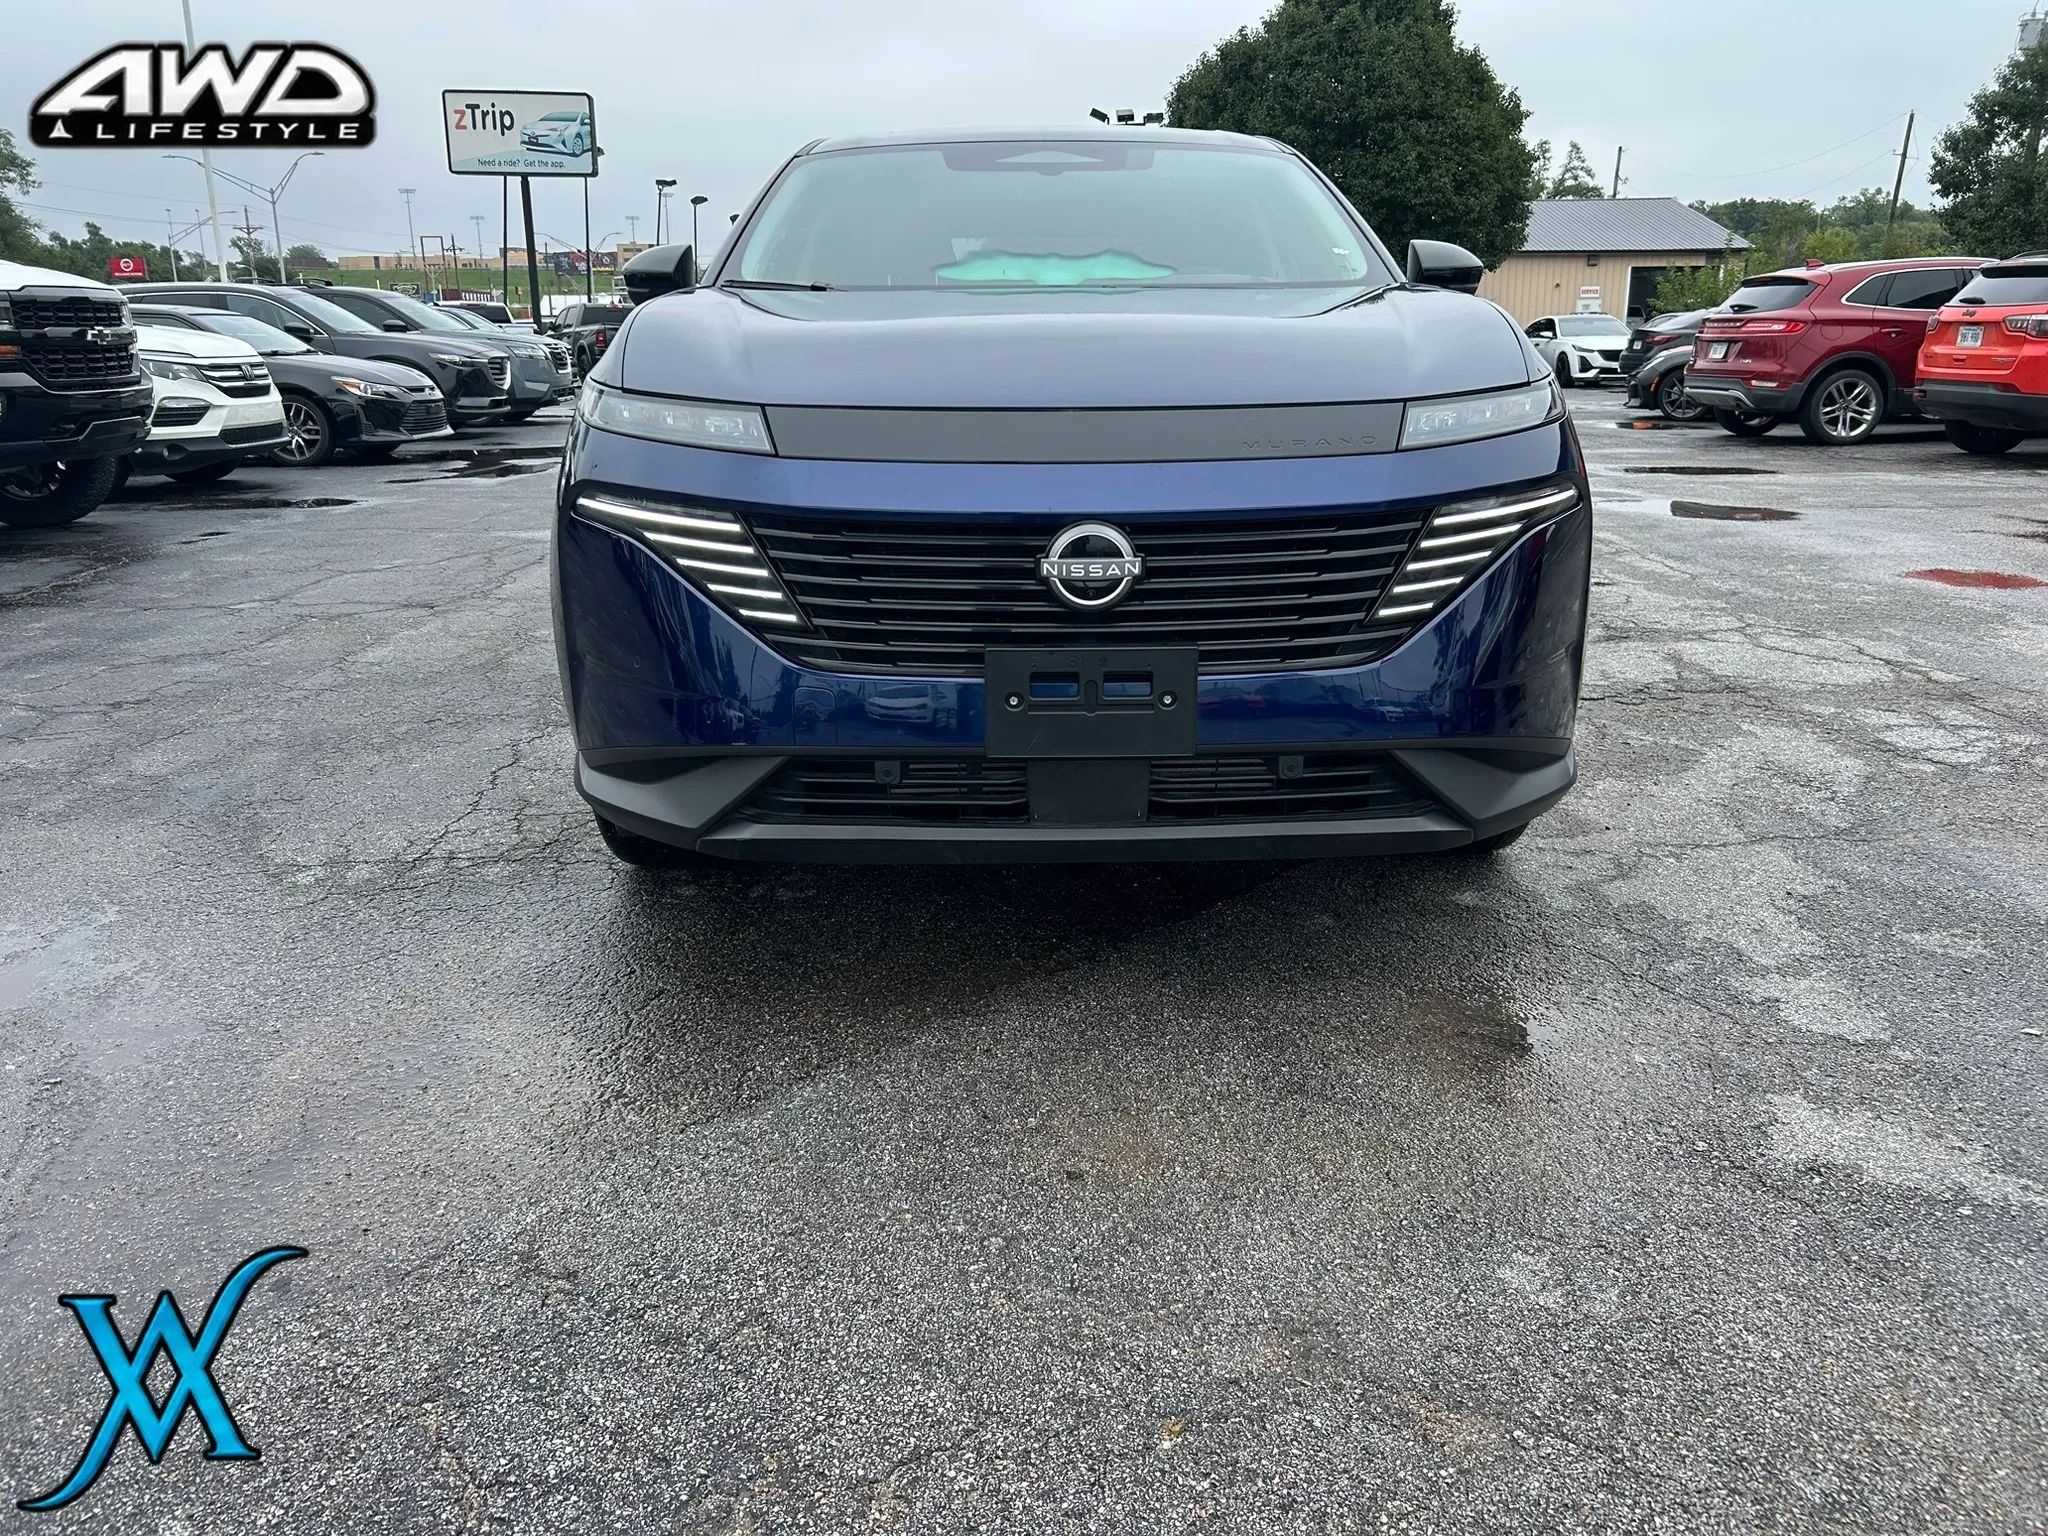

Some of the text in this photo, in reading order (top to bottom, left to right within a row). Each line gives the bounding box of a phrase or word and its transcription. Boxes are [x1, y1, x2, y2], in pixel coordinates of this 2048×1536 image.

[454, 102, 515, 137] zTrip
[477, 158, 496, 167] Need
[503, 158, 521, 168] ride?
[523, 158, 537, 168] Get
[537, 159, 550, 168] the
[550, 160, 566, 169] app.
[1242, 435, 1377, 451] MURANO
[1043, 561, 1140, 577] NISSAN
